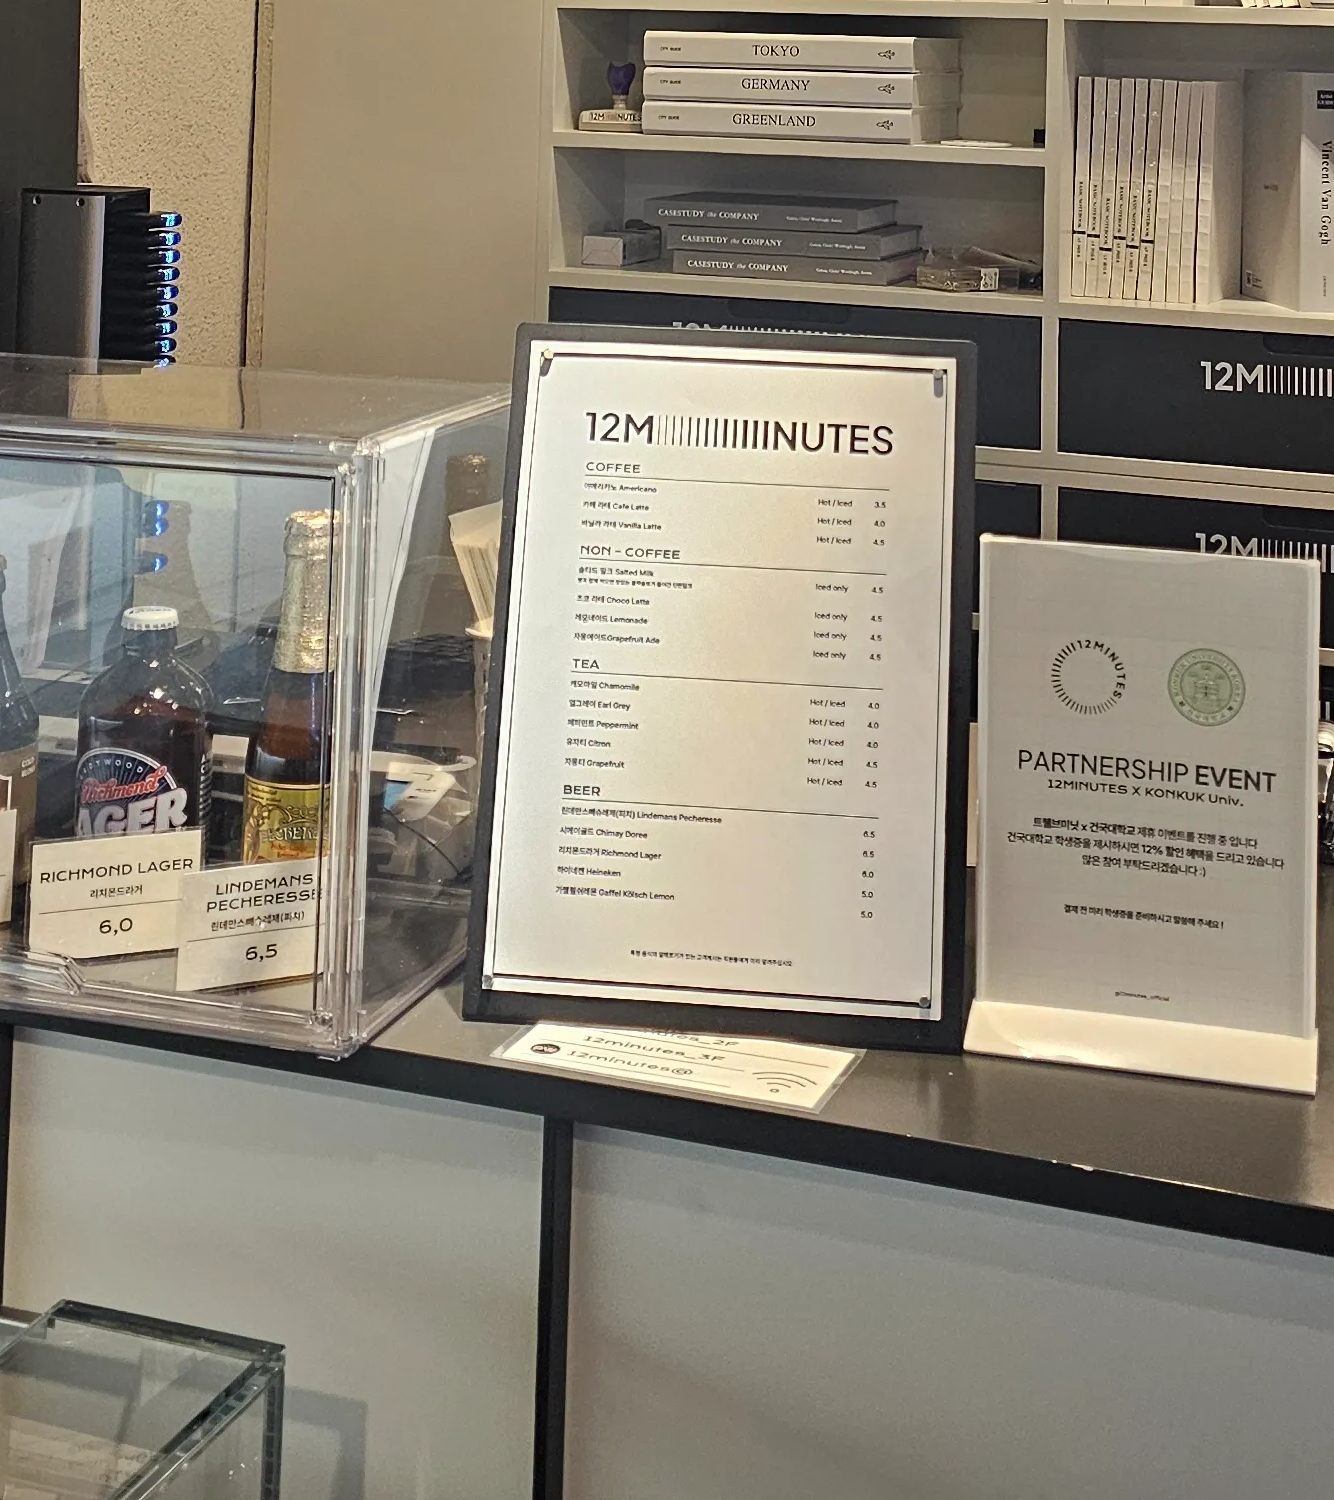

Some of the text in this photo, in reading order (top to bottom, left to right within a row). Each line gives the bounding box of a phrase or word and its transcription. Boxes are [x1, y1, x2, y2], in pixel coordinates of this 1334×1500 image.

[753, 45, 799, 56] TOKYO
[742, 78, 810, 90] GERMANY
[733, 114, 815, 126] GREENLAND
[1319, 140, 1333, 244] Vincent Van Gogh
[659, 209, 759, 220] CASESTUDY COMPANY
[682, 235, 782, 246] CASESTUDY COMPANY
[688, 260, 788, 272] CASESTUDY COMPANY
[586, 462, 640, 473] COFFEE
[619, 485, 657, 493] Americano
[581, 546, 680, 561] NON COFFEE
[573, 659, 599, 669] TEA
[597, 721, 638, 729] Peppermint
[1019, 750, 1276, 794] PARTNERSHIP EVENT
[564, 785, 600, 796] BEER
[1048, 779, 1127, 794] 12MINUTES
[1146, 788, 1204, 802] KONKUK
[1209, 794, 1243, 806] Univ.
[637, 812, 677, 820] Lindemans
[596, 829, 623, 838] Chimay
[601, 850, 639, 859] Richmond
[1142, 845, 1163, 855] 12%
[41, 859, 193, 883] RICHMOND LAGER
[587, 868, 621, 876] Heineken
[216, 874, 313, 896] LINDEMANS
[100, 918, 132, 935] 6,0
[246, 944, 277, 962] 6,5
